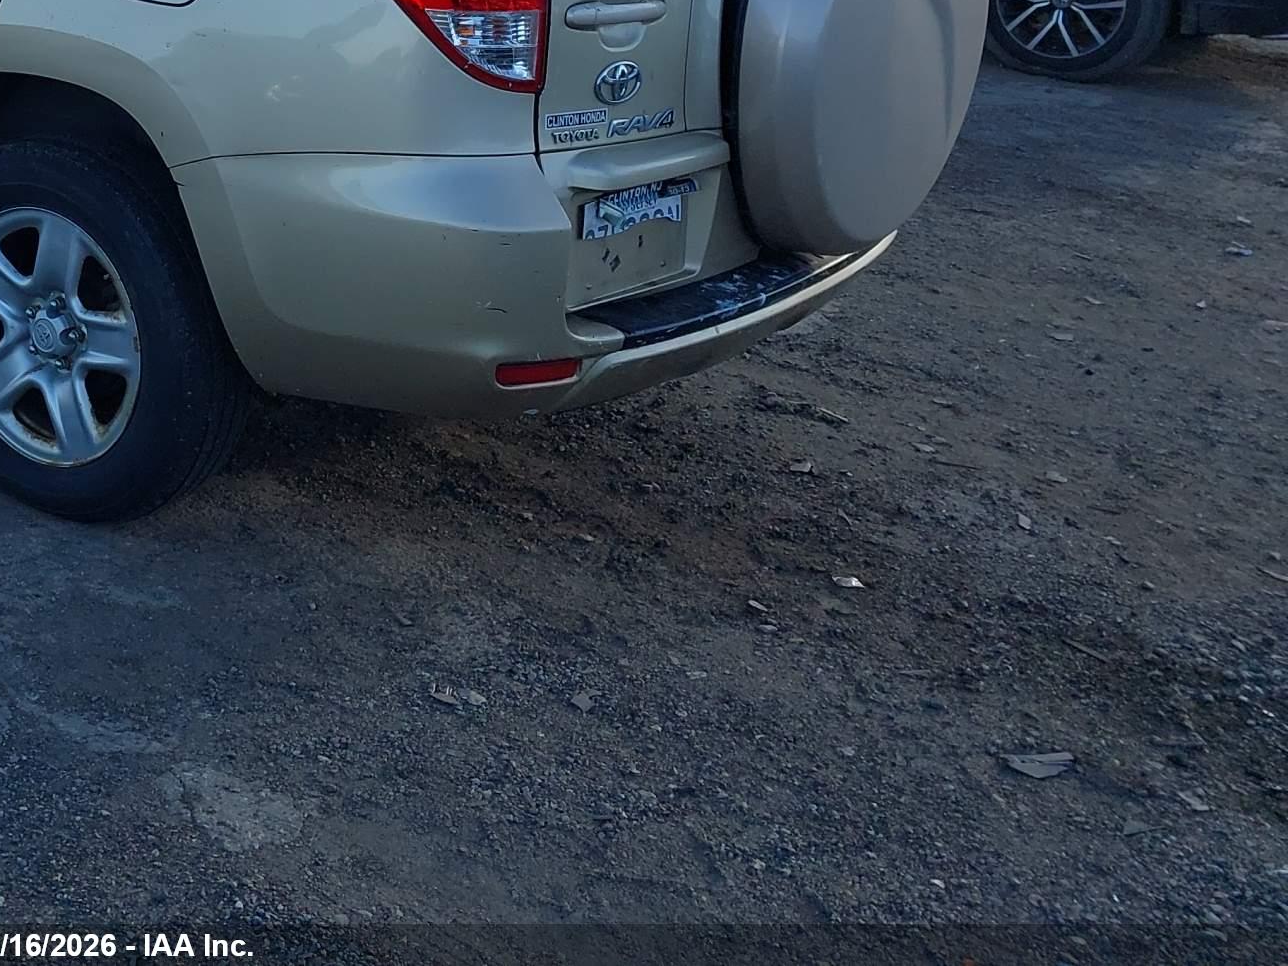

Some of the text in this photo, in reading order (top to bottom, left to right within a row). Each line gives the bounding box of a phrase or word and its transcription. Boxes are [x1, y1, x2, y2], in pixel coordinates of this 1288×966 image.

[547, 110, 607, 128] CLINTON HONDA
[607, 107, 675, 138] RAV4
[551, 128, 600, 144] TOYOTA
